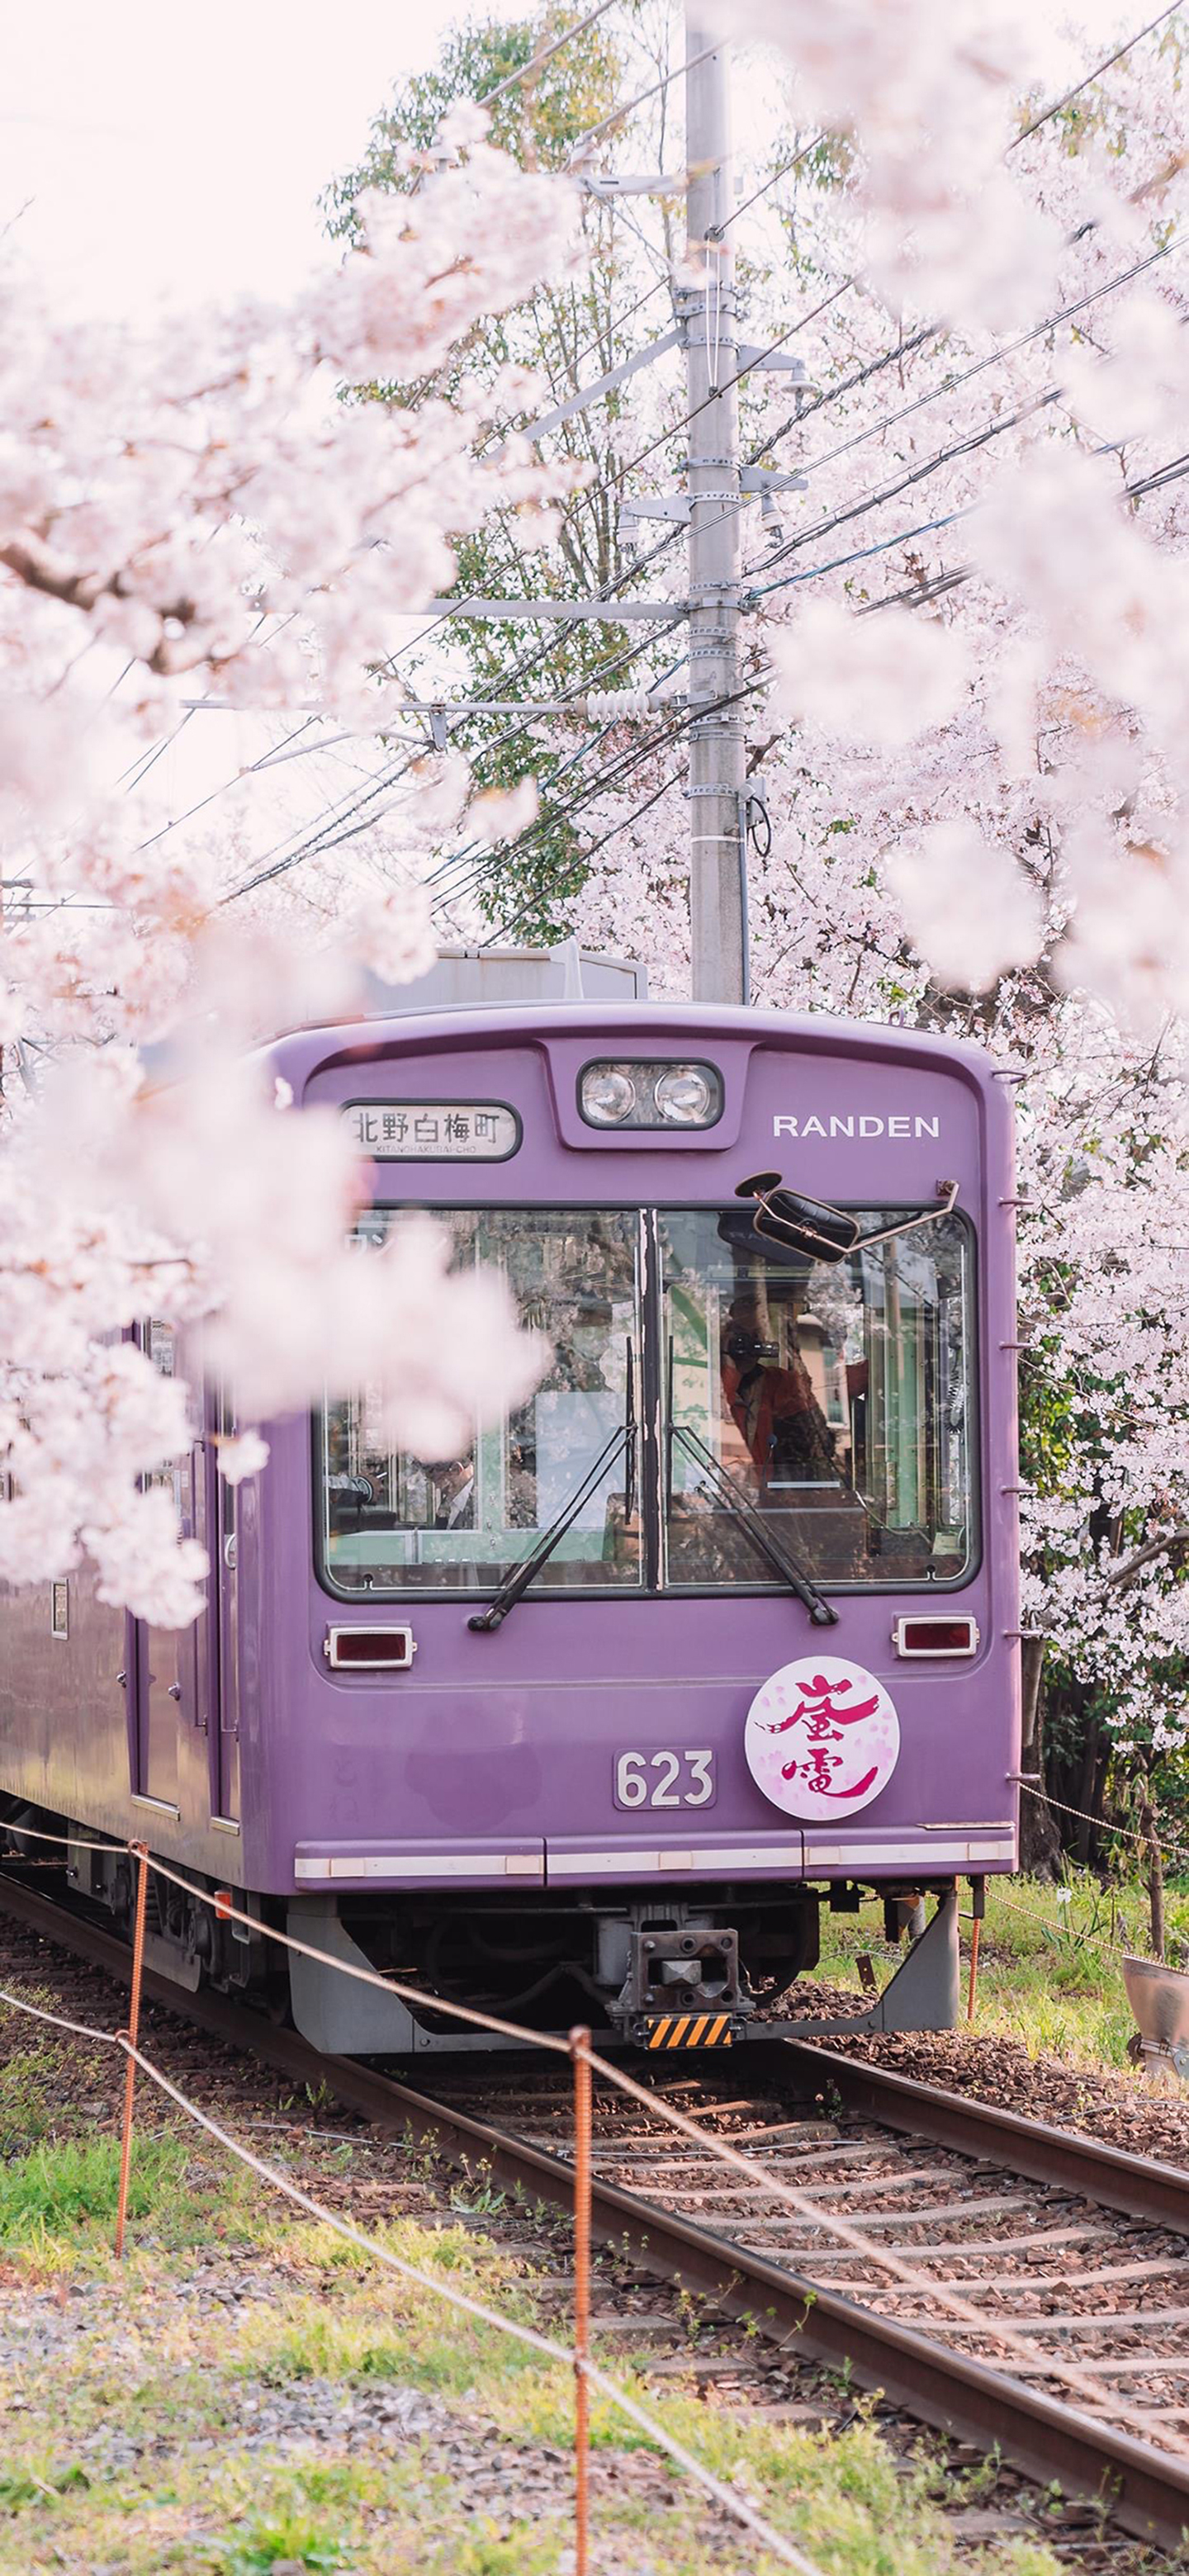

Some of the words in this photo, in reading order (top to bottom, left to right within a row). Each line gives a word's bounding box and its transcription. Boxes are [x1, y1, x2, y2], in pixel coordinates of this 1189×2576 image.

[353, 1112, 500, 1144] 北野白梅町
[773, 1115, 940, 1138] RANDEN
[753, 1674, 879, 1799] 嵐電
[618, 1750, 713, 1807] 623
